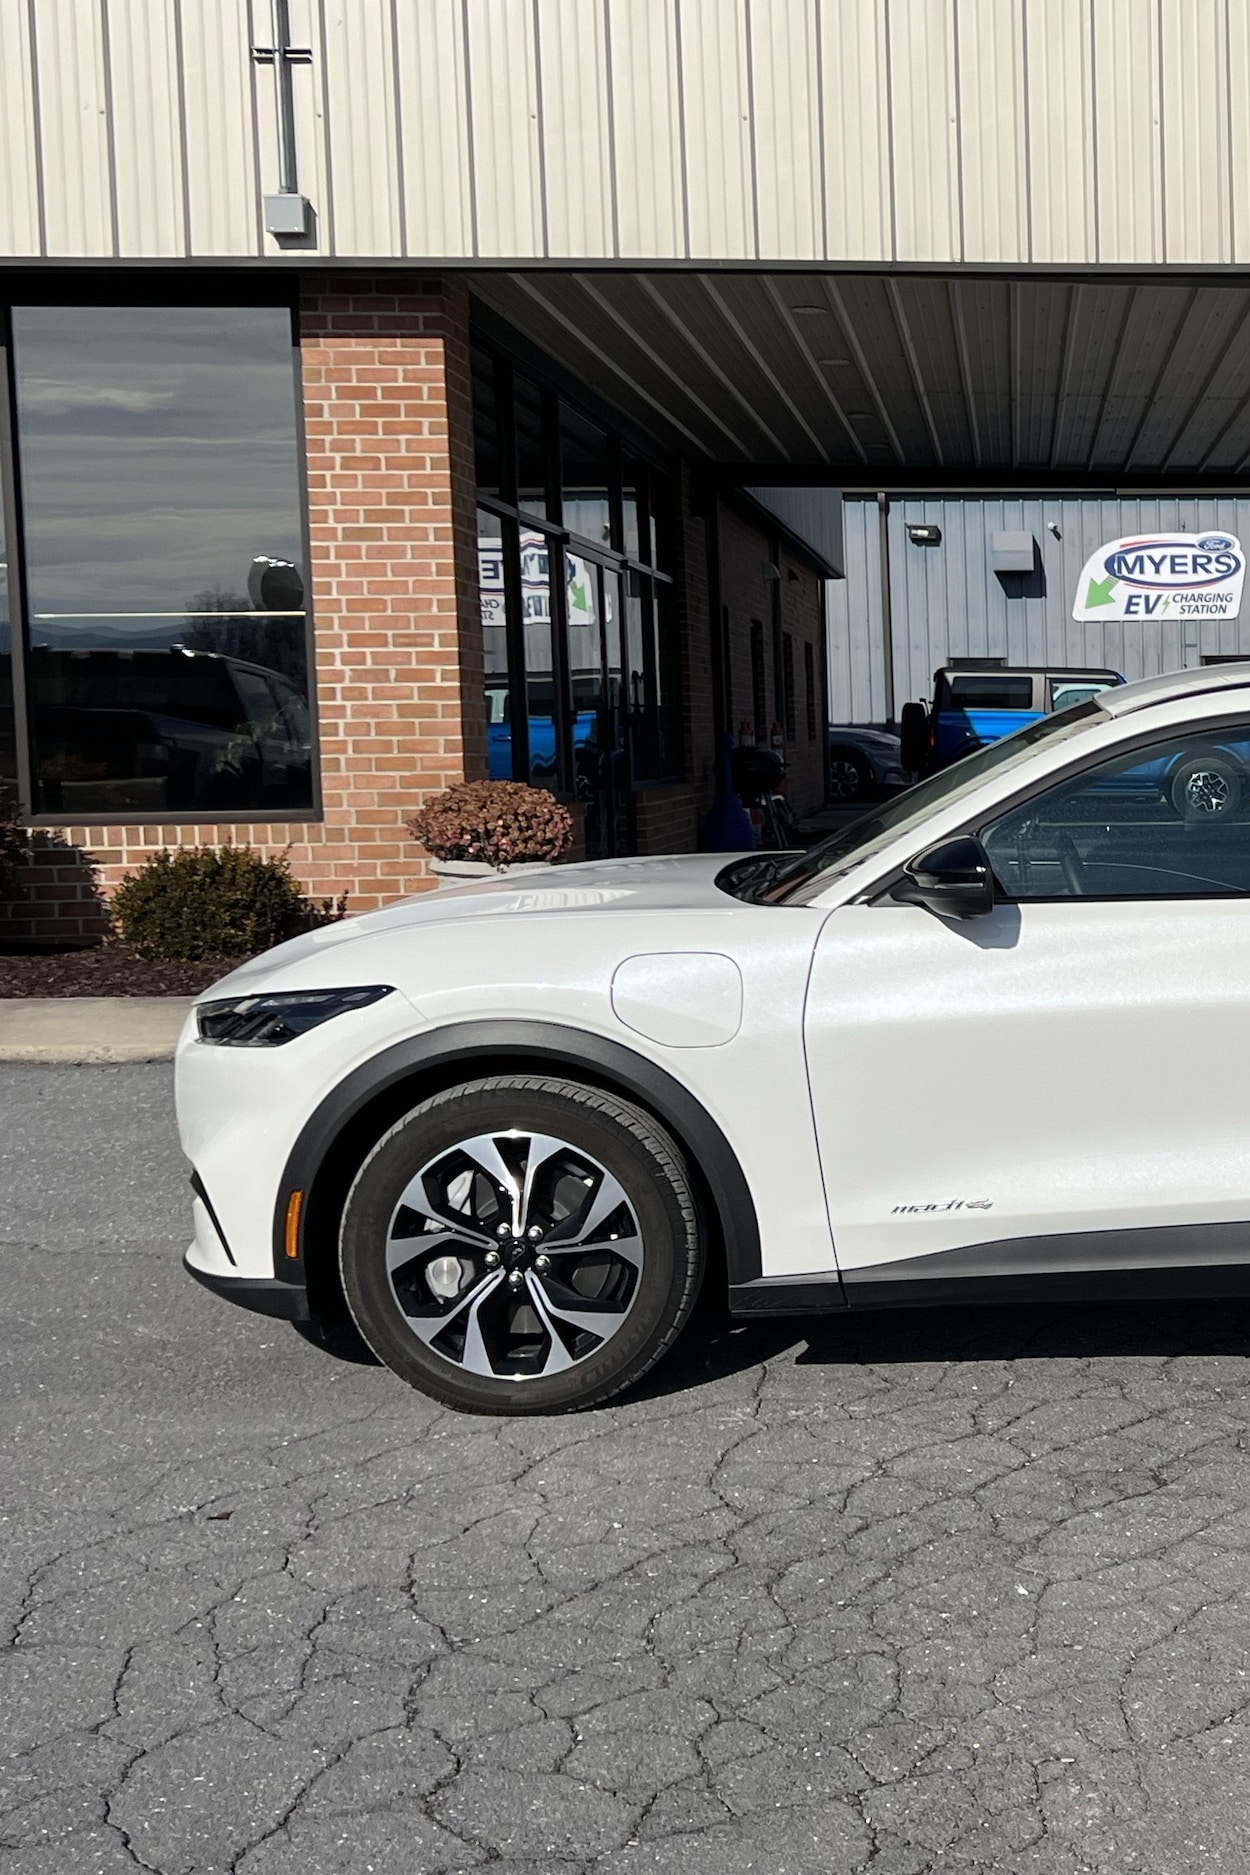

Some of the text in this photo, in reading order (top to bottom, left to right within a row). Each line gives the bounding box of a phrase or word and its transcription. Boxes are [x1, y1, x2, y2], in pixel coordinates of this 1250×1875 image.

[1202, 538, 1227, 551] Ford
[1115, 553, 1234, 576] MYERS
[1123, 594, 1164, 615] EV
[1172, 592, 1234, 604] CHARGING
[1178, 604, 1228, 615] STATION
